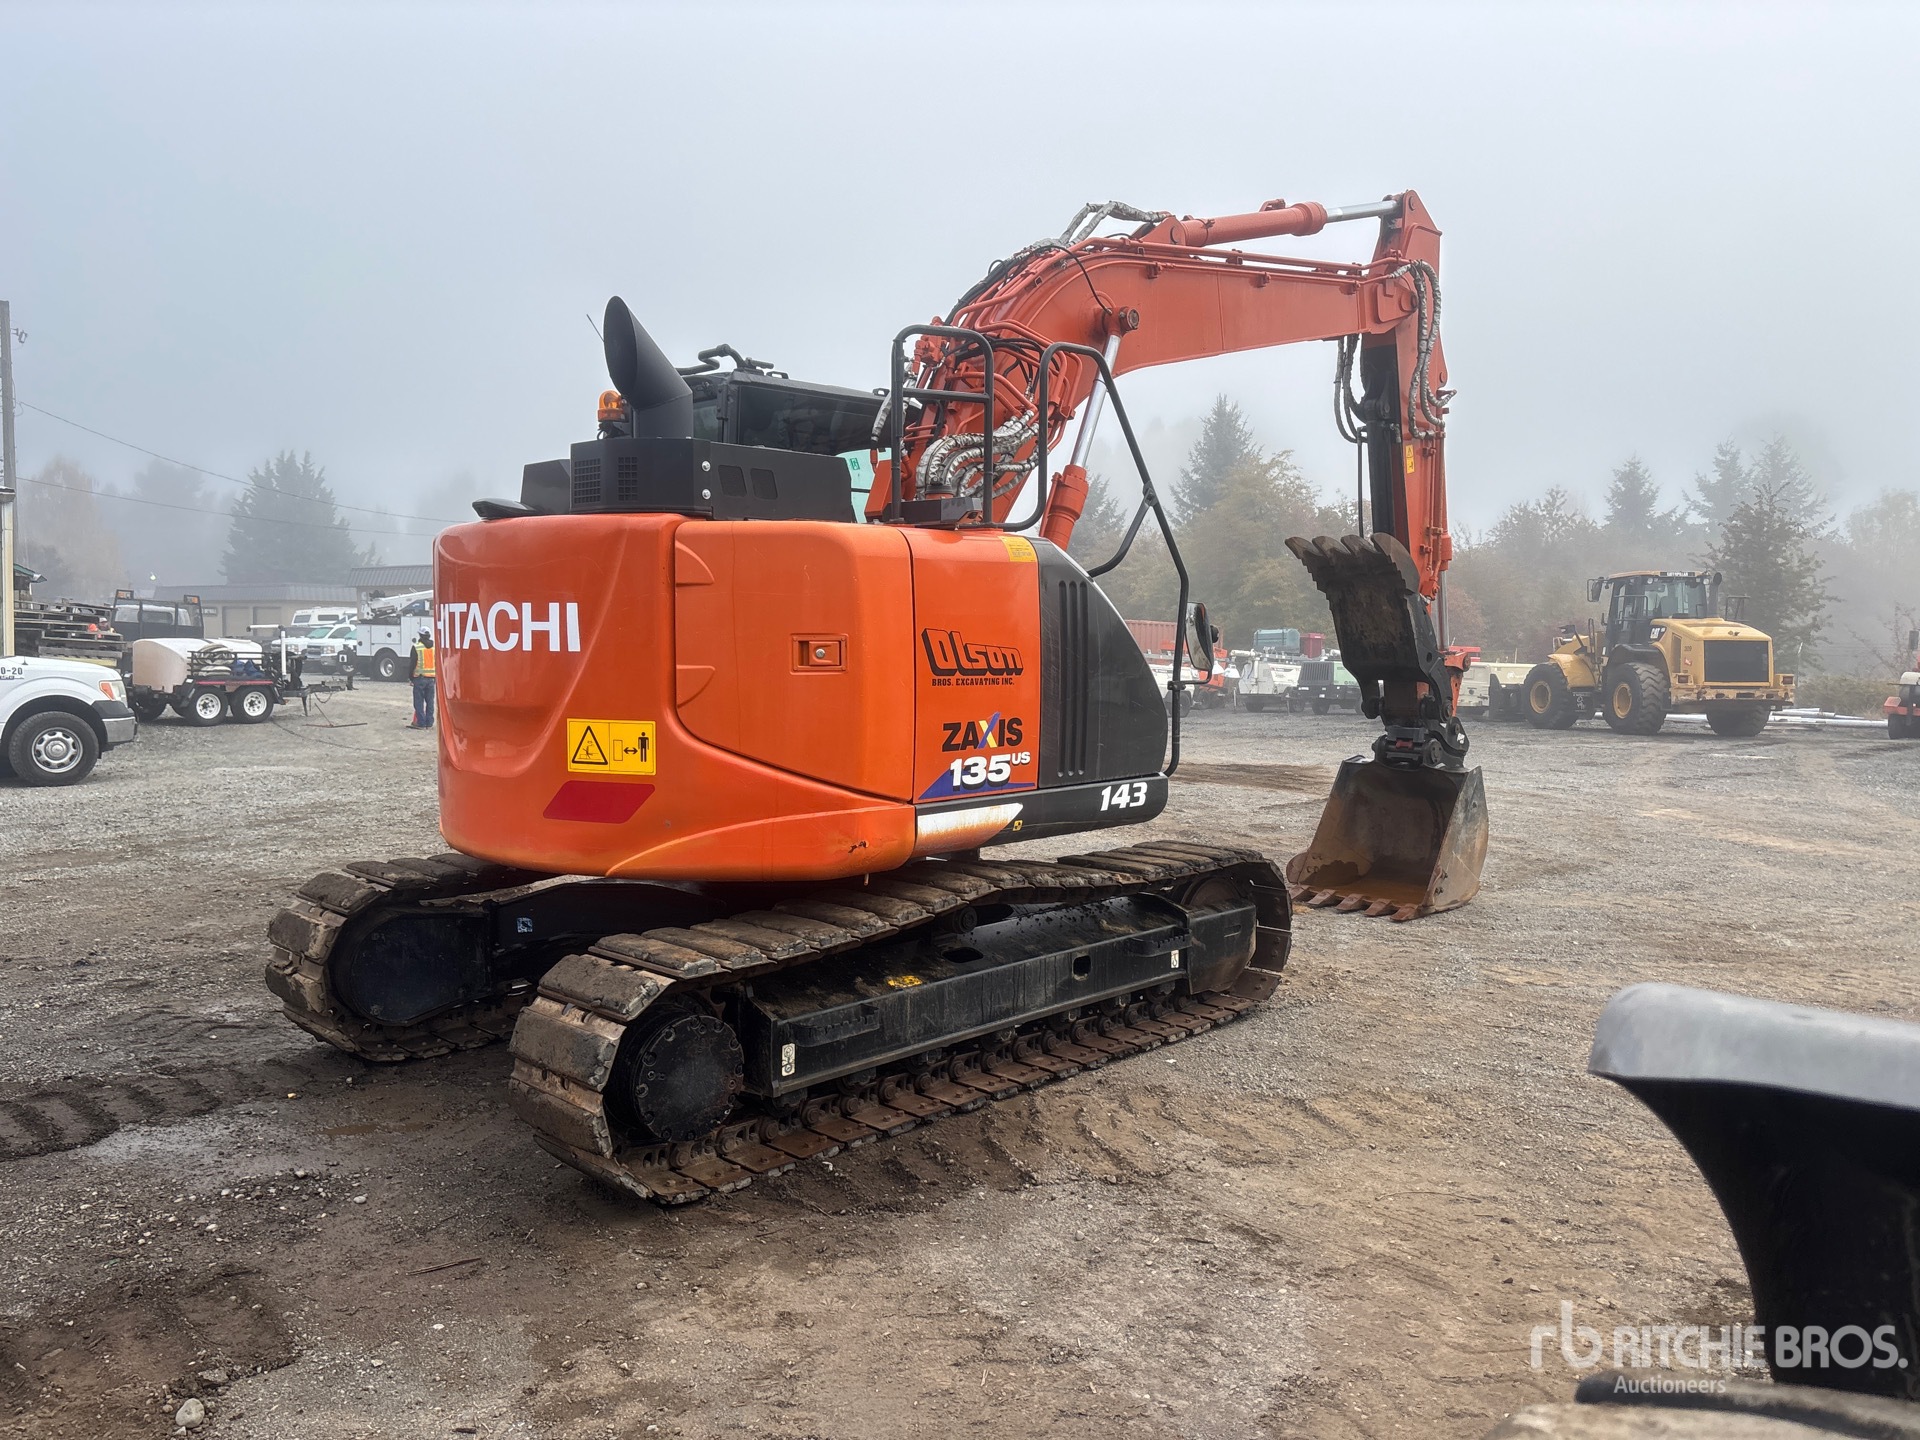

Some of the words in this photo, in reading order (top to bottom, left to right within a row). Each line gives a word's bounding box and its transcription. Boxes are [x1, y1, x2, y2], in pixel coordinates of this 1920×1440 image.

[436, 601, 581, 652] HITACHI
[921, 628, 1024, 676] Olson
[931, 678, 954, 686] BROS.
[955, 677, 1000, 686] EXCAVATING
[1001, 677, 1015, 685] INC.
[941, 711, 1023, 752] ZAXIS
[949, 753, 1011, 791] 135
[1011, 751, 1031, 765] US
[1100, 782, 1148, 812] 143
